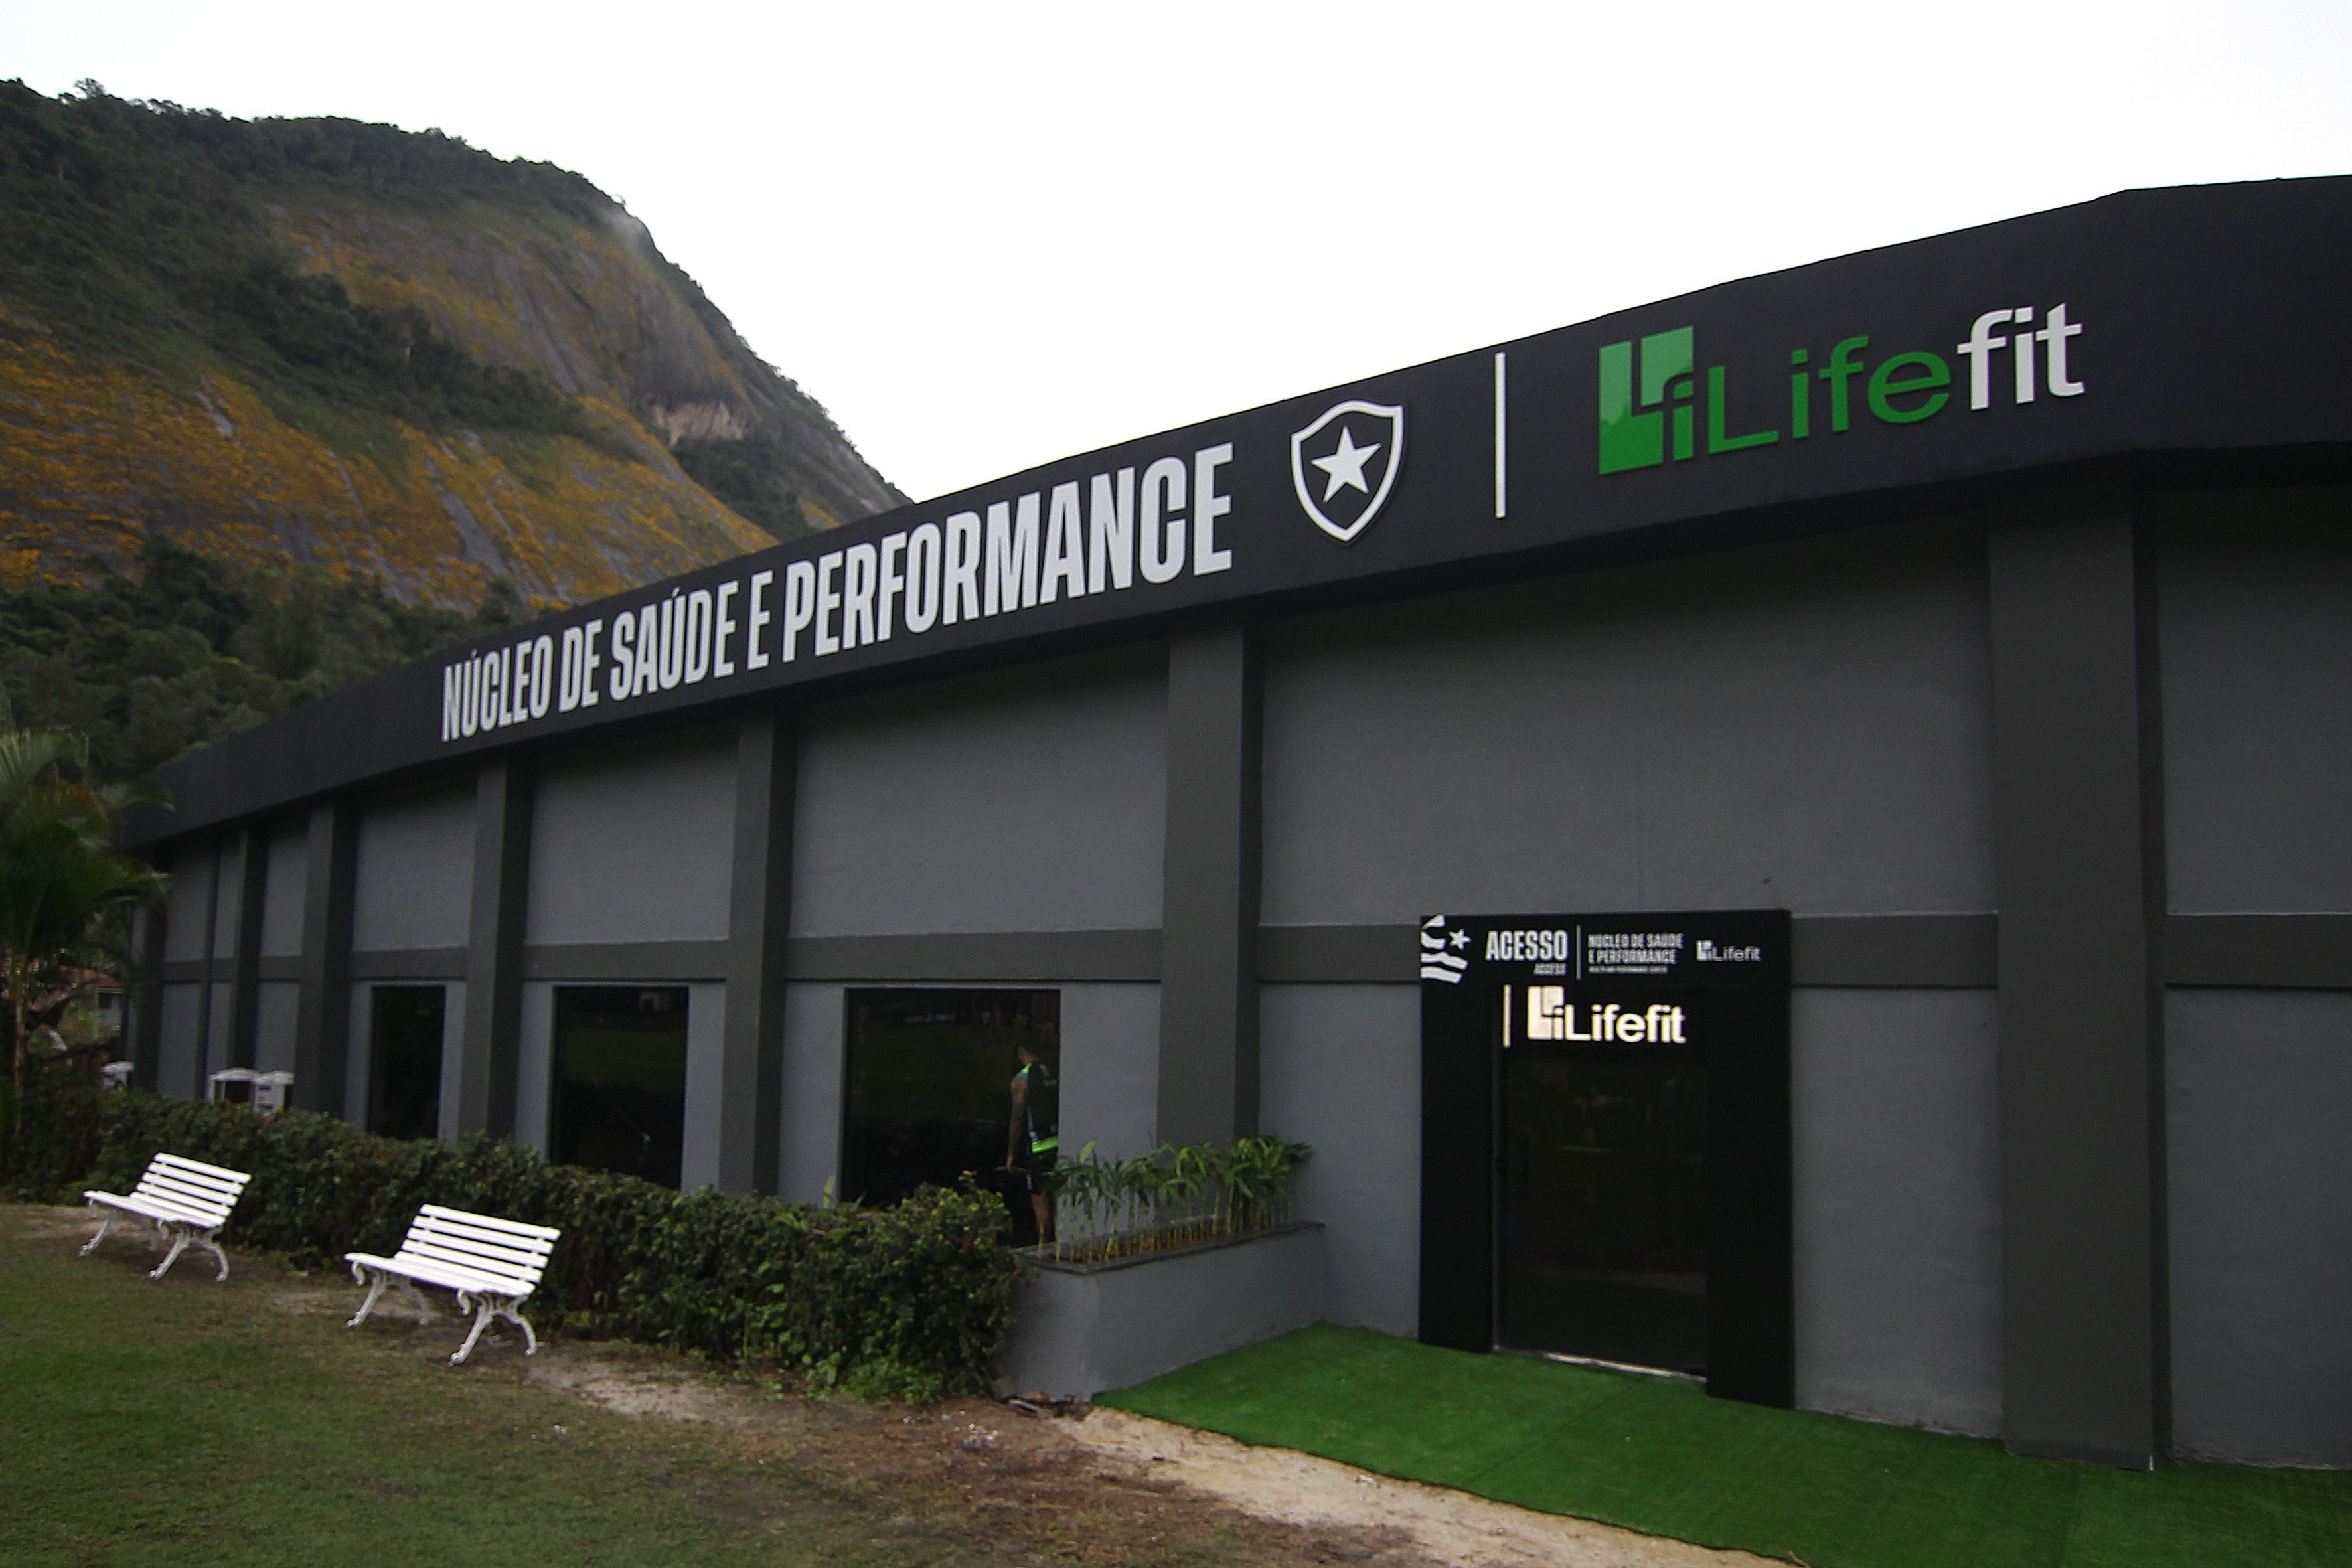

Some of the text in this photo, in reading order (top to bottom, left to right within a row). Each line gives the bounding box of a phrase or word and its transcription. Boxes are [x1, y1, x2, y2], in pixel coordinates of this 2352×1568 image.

[1708, 302, 2085, 455] Lifefit
[442, 442, 1234, 742] NÚCLEO DE SAÚDE E PERFORMANCE
[1485, 929, 1569, 961] ACESSO
[1596, 949, 1676, 964] PERFORMANCE
[1630, 933, 1646, 949] DE
[1565, 1004, 1687, 1044] Lifefit
